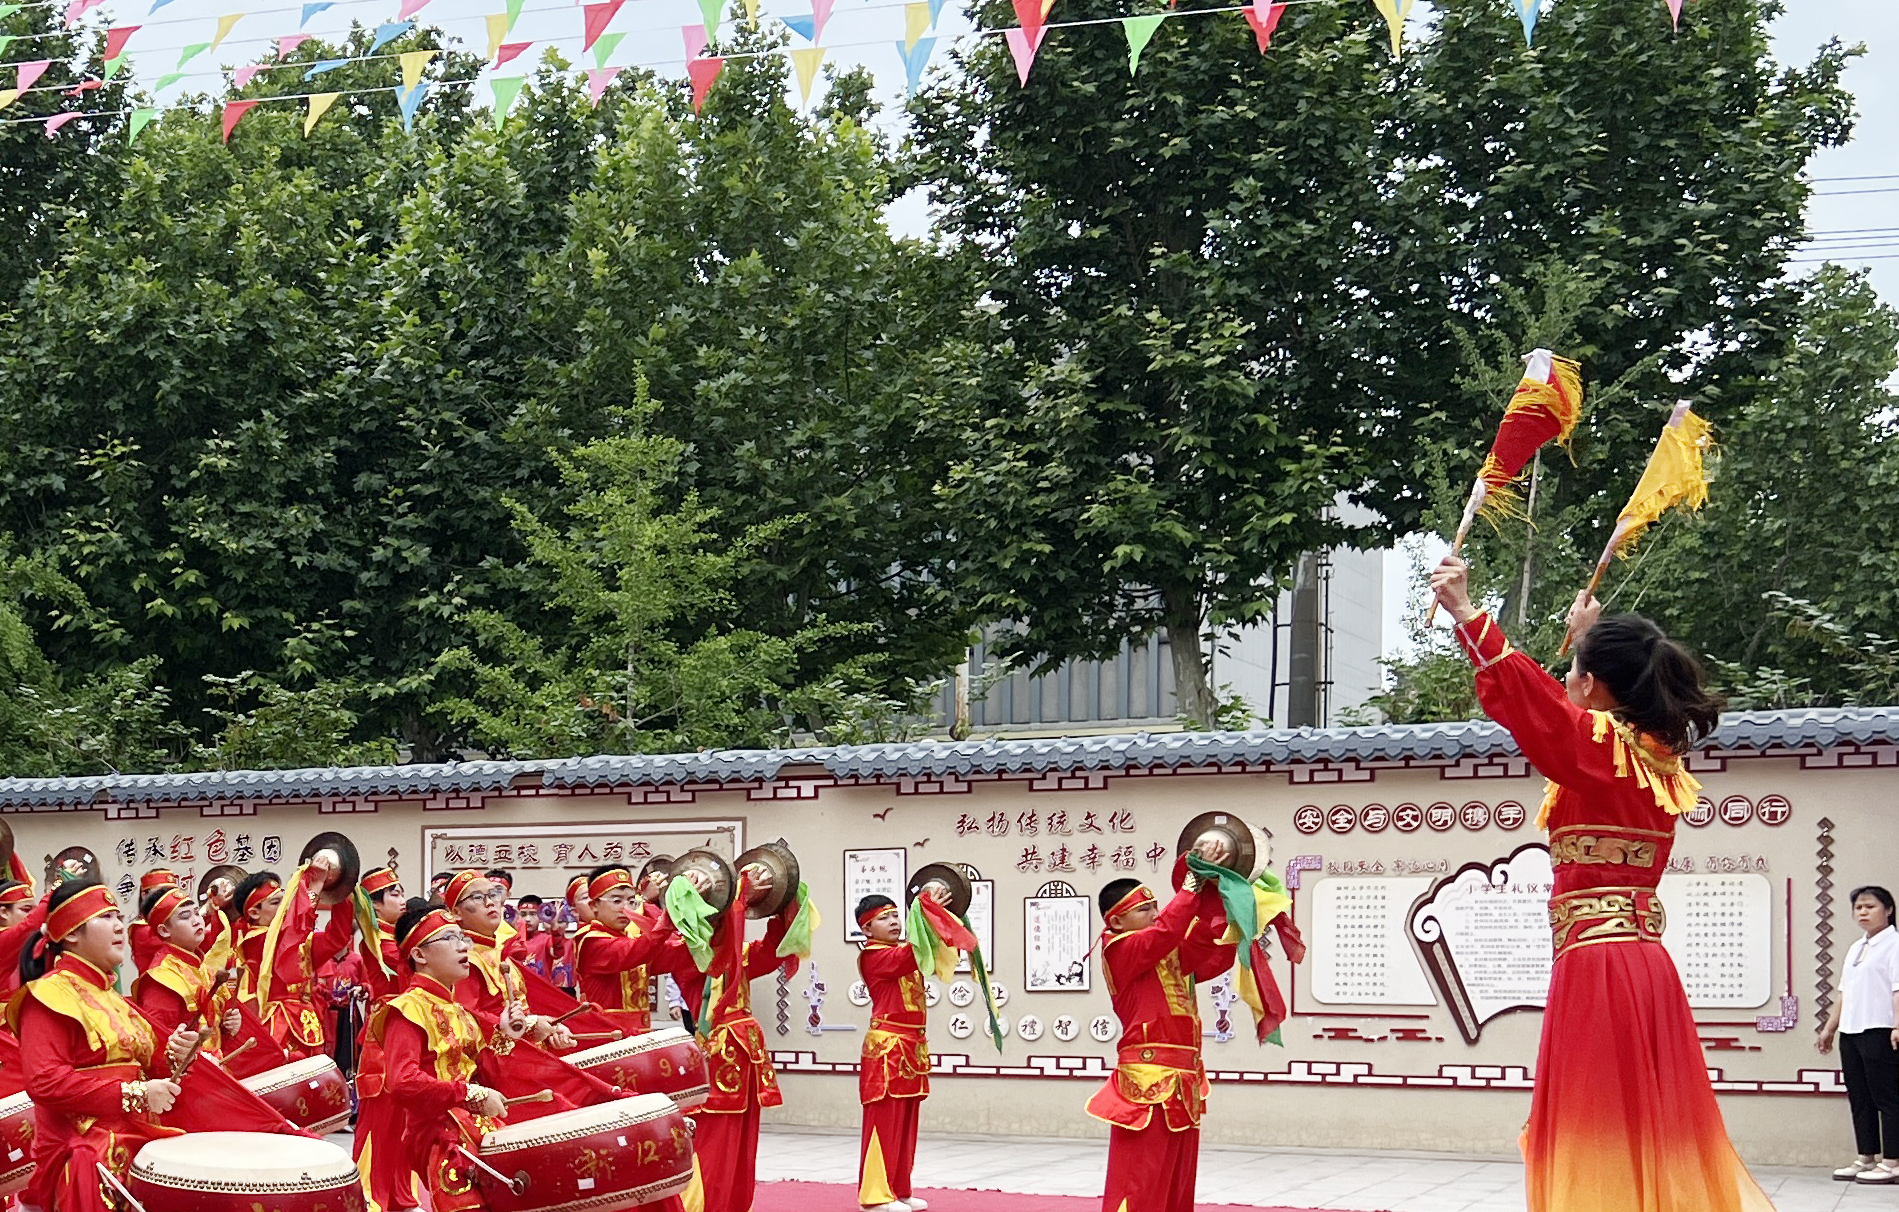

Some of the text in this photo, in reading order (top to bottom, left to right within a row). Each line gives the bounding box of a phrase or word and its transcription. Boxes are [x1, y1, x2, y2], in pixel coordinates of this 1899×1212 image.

[956, 808, 1136, 837] 弘扬传统文化
[117, 828, 282, 866] 传承红色基因
[444, 841, 653, 864] 以德立校 育人为本
[296, 1097, 309, 1116] 8
[637, 1139, 660, 1166] 12
